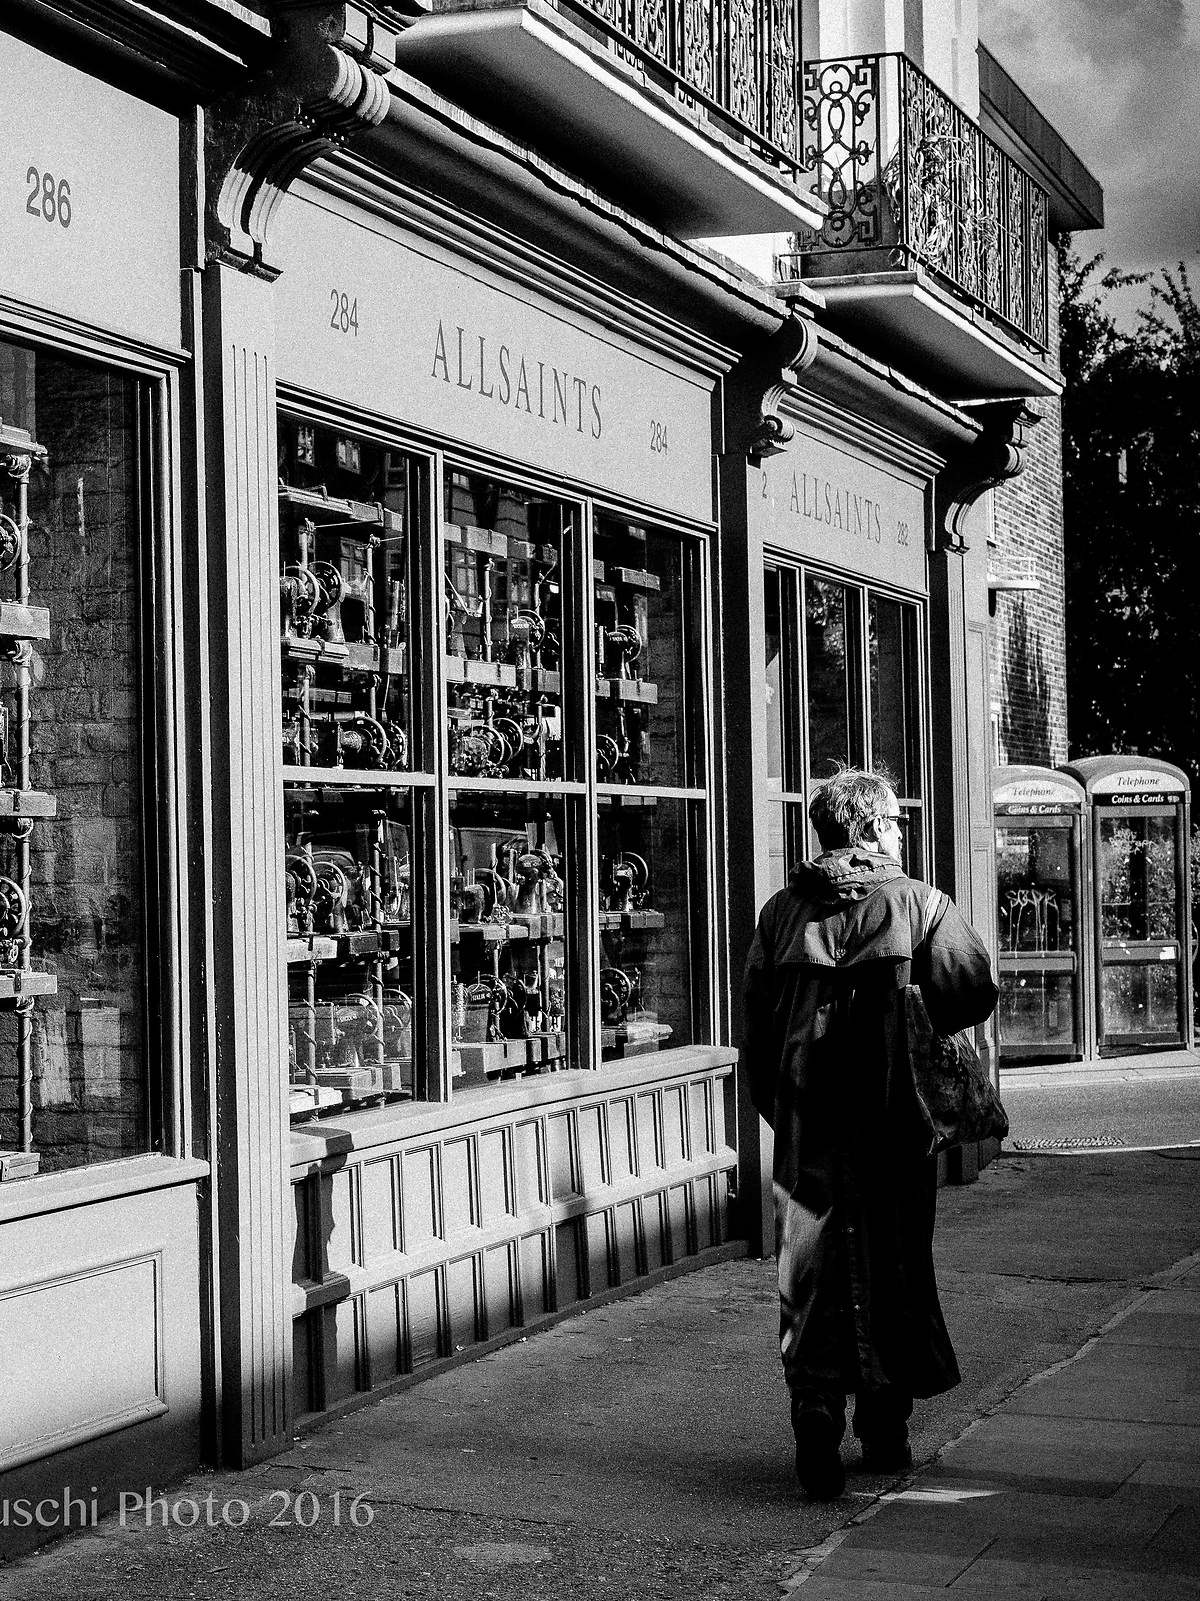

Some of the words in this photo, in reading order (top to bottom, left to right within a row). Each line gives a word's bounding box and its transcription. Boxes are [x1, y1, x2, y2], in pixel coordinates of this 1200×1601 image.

[26, 166, 72, 229] 286
[330, 288, 359, 336] 284
[431, 318, 603, 440] ALLSAINTS
[649, 419, 668, 453] 284
[789, 469, 881, 544] ALLSAINTS
[1013, 786, 1054, 797] Telephone
[1111, 794, 1133, 804] Coins
[1133, 794, 1141, 803] &
[1142, 793, 1164, 803] Cards
[1117, 776, 1160, 787] Telephone
[1008, 805, 1029, 815] Coins
[1030, 805, 1038, 814] &
[1039, 804, 1062, 814] Cards
